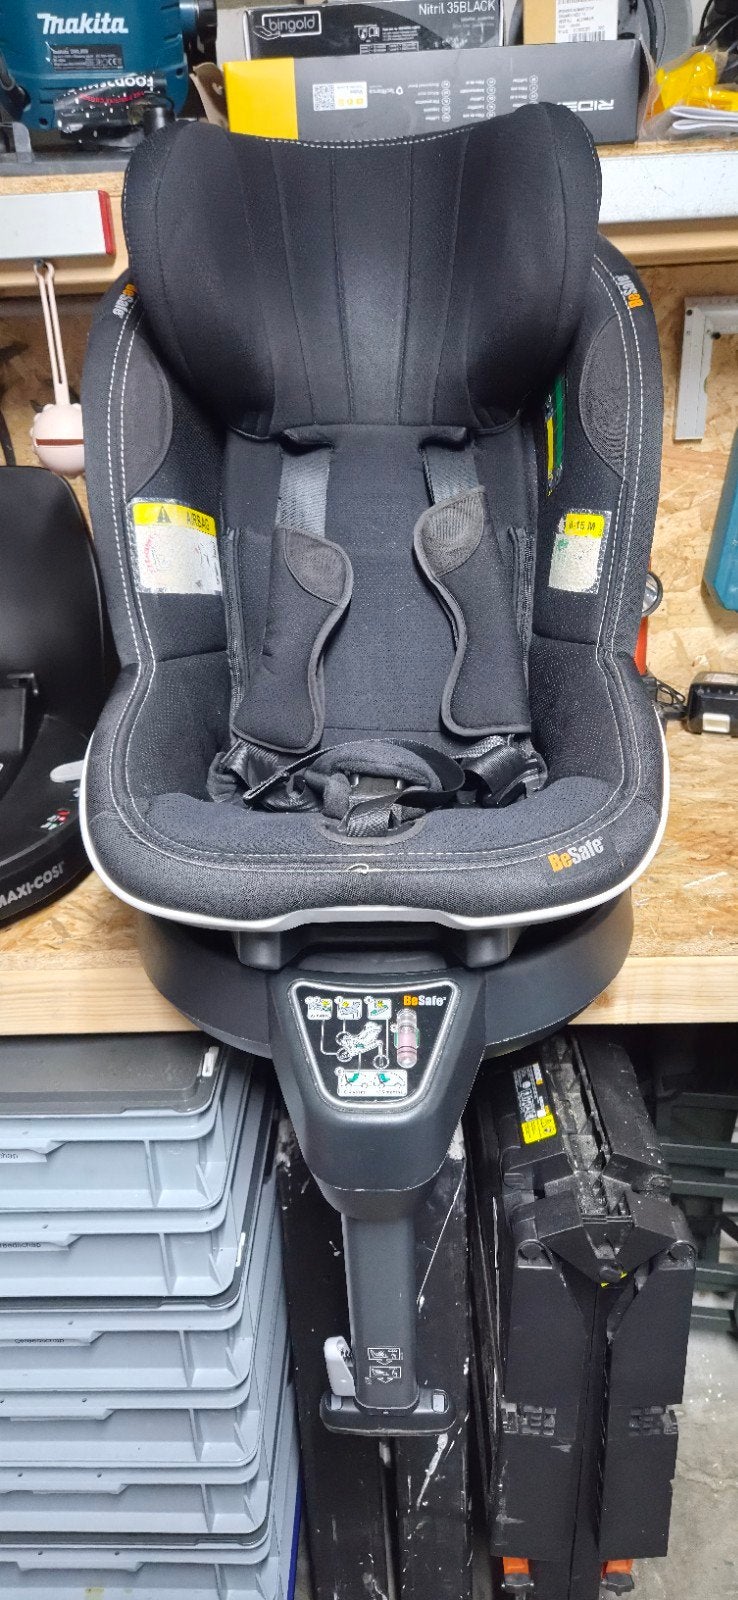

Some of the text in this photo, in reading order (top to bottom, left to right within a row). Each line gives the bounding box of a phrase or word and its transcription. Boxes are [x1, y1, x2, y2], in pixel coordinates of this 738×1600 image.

[418, 2, 445, 15] Nitril
[37, 13, 129, 35] Makita
[268, 15, 316, 33] bingold
[557, 99, 615, 113] RIDE
[547, 836, 604, 872] BeSafe
[403, 994, 444, 1007] BeSafe
